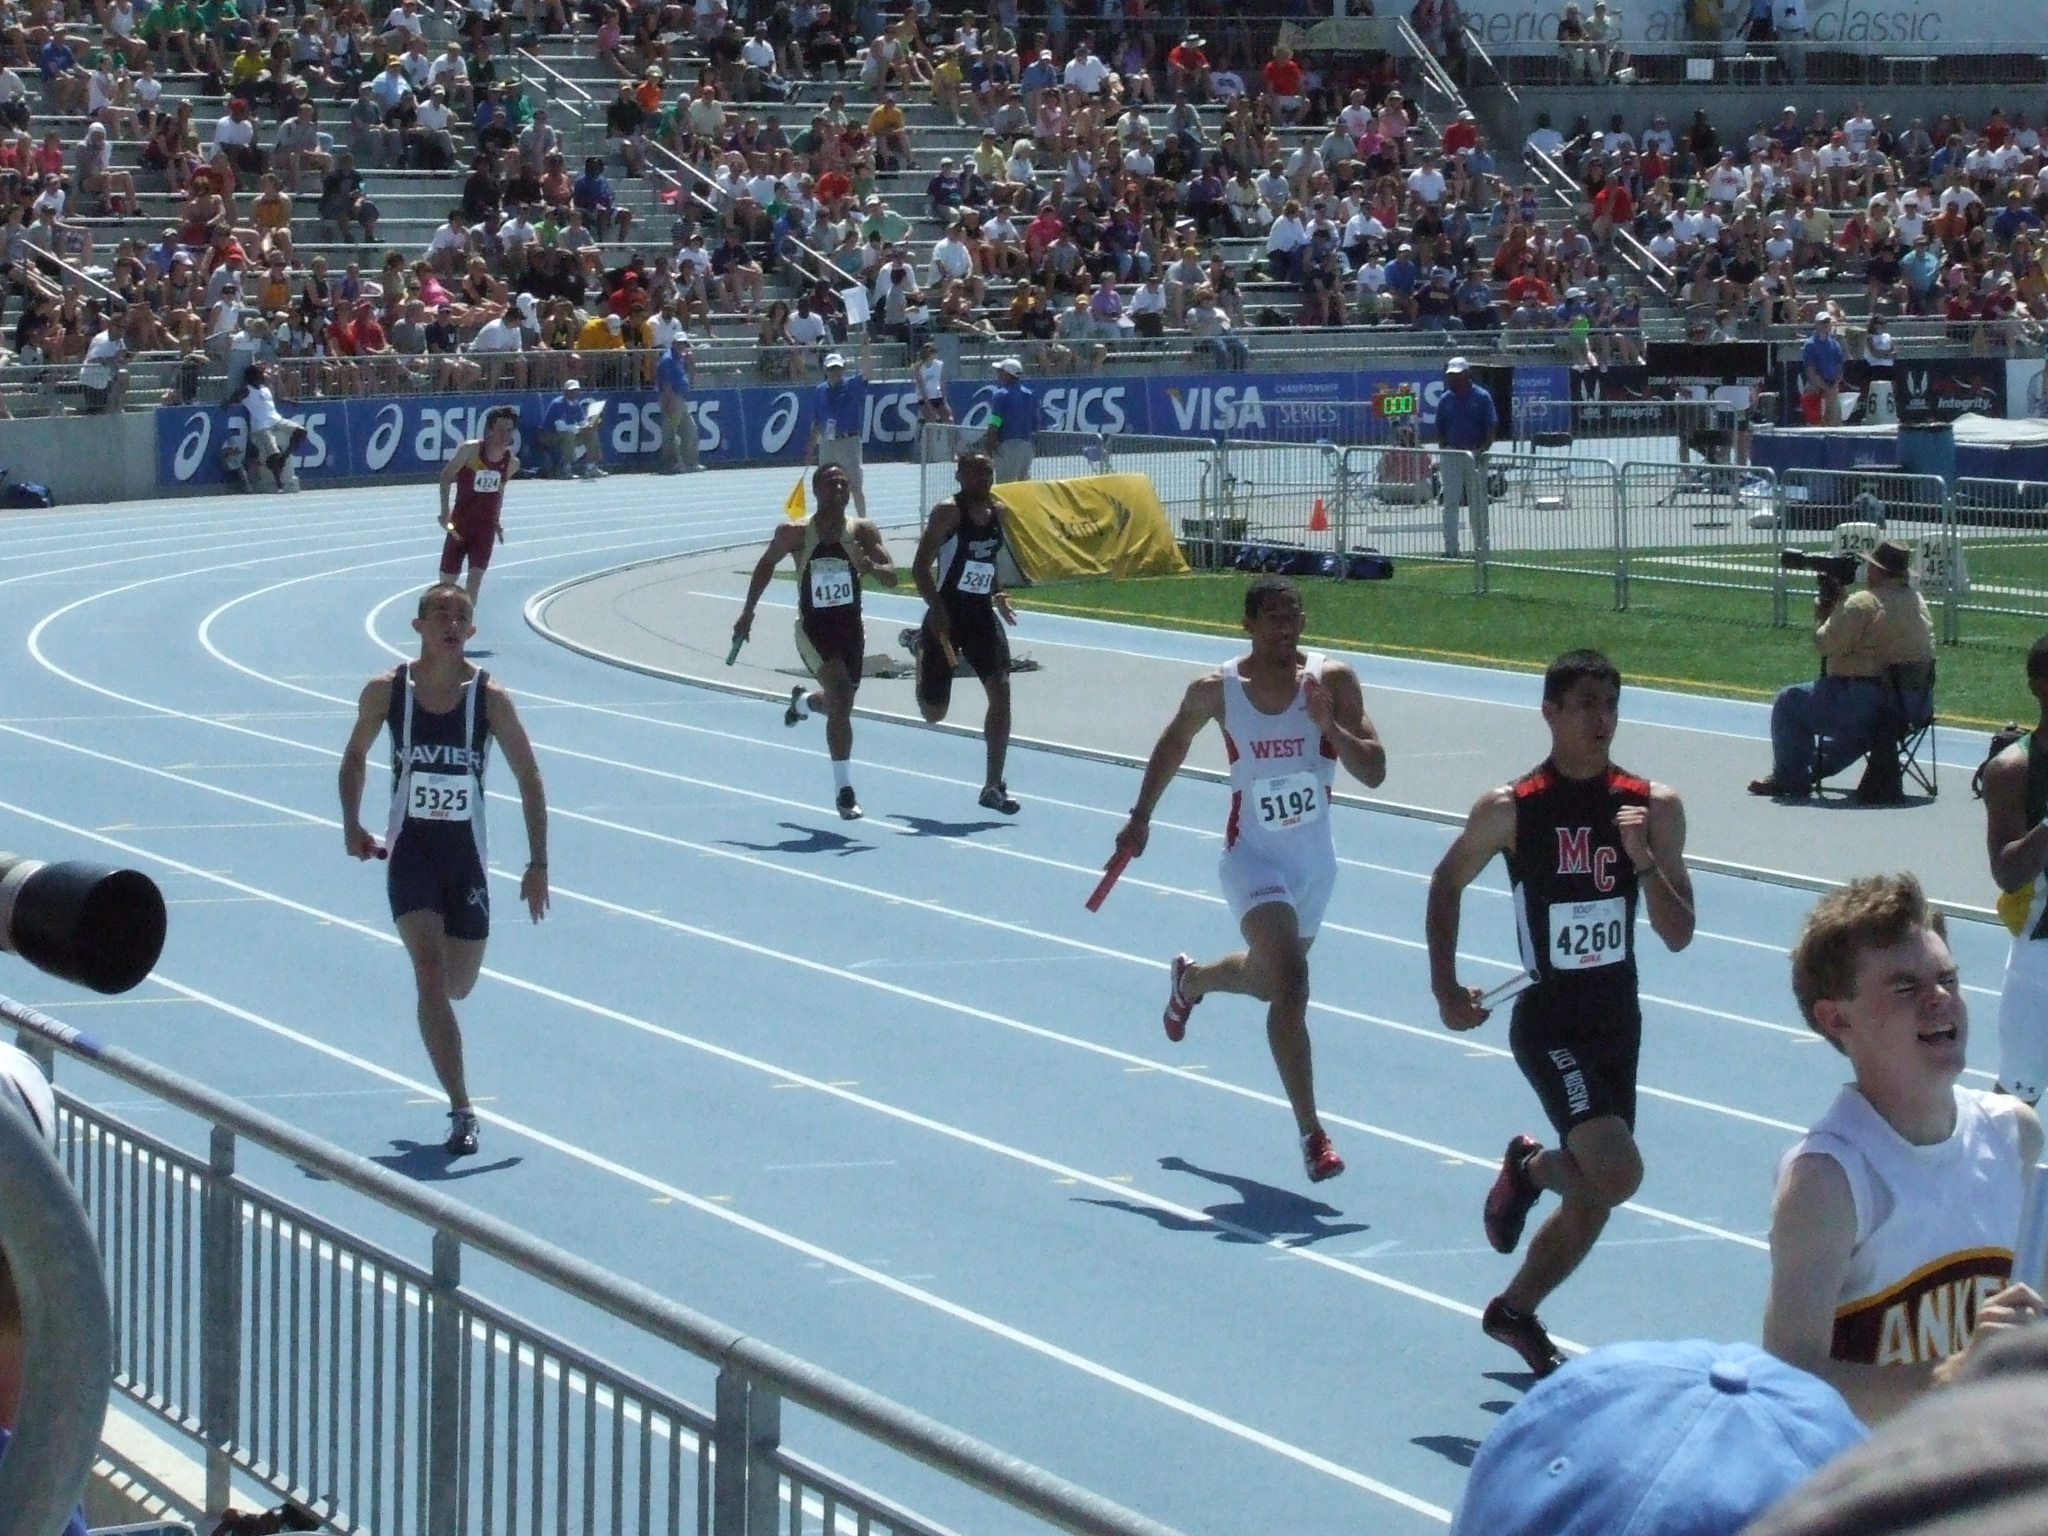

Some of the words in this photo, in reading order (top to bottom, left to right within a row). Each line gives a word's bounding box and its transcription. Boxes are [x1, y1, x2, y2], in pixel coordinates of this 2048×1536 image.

[1813, 0, 1943, 42] classic
[1166, 386, 1267, 431] VISA
[815, 583, 851, 600] 4120
[1250, 738, 1305, 760] WEST
[415, 786, 467, 811] 5325
[1260, 787, 1316, 822] 5192
[1556, 920, 1622, 955] 4260
